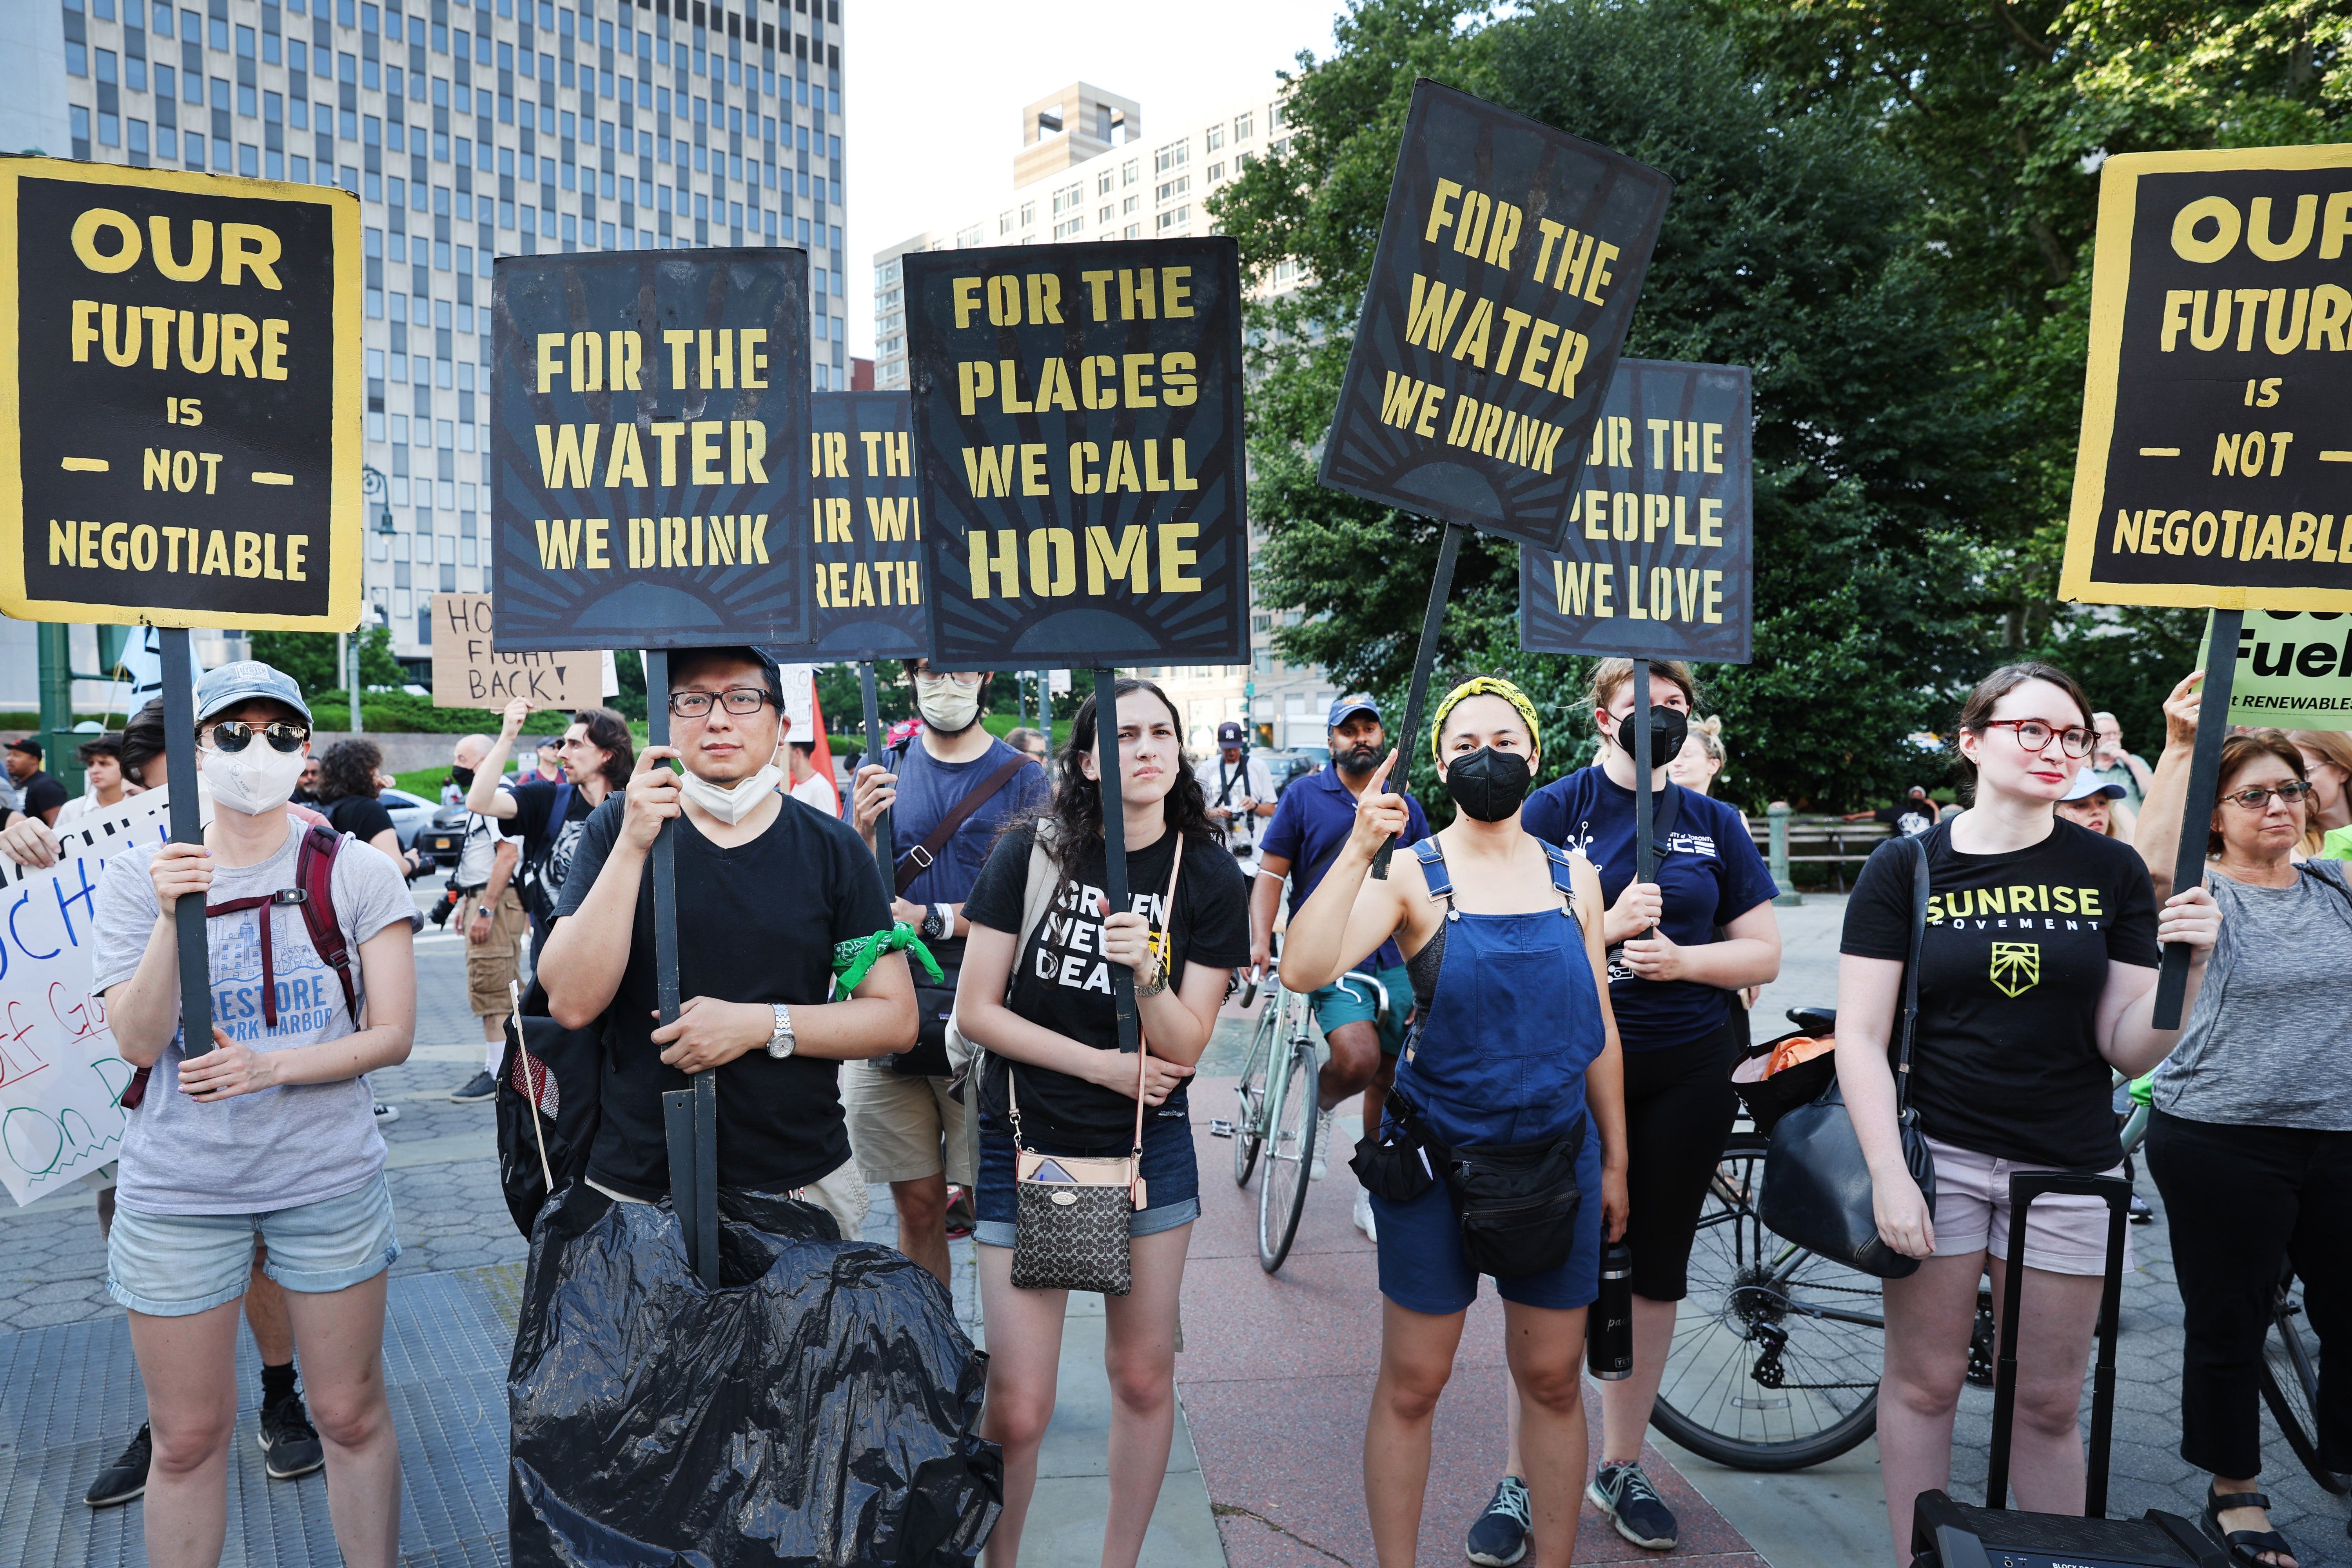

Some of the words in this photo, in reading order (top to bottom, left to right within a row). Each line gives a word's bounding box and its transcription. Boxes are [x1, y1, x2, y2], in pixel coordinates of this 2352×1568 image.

[71, 208, 282, 290] OUR
[1425, 178, 1523, 271] FOR
[1533, 218, 1620, 307] THE
[953, 274, 1064, 328] FOR
[1082, 267, 1194, 321] THE
[2160, 284, 2352, 355] FUTUR
[72, 300, 289, 380] FUTURE
[537, 331, 642, 393] FOR
[664, 329, 768, 389] THE
[1405, 272, 1590, 399] WATER
[167, 397, 203, 426] IS
[958, 352, 1198, 416] PLACES
[2244, 377, 2283, 408] IS
[1380, 370, 1446, 439] WE
[1446, 394, 1564, 475] DRINK
[1648, 419, 1723, 474] THE
[143, 448, 223, 494] NOT
[535, 420, 768, 488] WATER
[860, 432, 916, 476] TH
[962, 443, 1049, 498] WE
[1070, 438, 1198, 494] CALL
[2212, 431, 2293, 477] NOT
[49, 520, 308, 581] NEGOTIABLE
[535, 519, 610, 570] WE
[629, 514, 769, 568] DRINK
[968, 522, 1202, 599] HOME
[816, 561, 924, 608] REATH
[1553, 561, 1613, 618] WE
[1629, 565, 1723, 624] LOVE
[448, 598, 493, 634] HO
[469, 666, 567, 701] BACK!
[2230, 696, 2238, 706] t
[239, 781, 251, 793] KN95
[1666, 837, 1716, 857] CE
[1057, 880, 1167, 926] GREN
[1926, 884, 2103, 922] SUNRISE
[1041, 911, 1106, 957] NE
[1036, 947, 1116, 996] DEA
[3, 1107, 96, 1174] On
